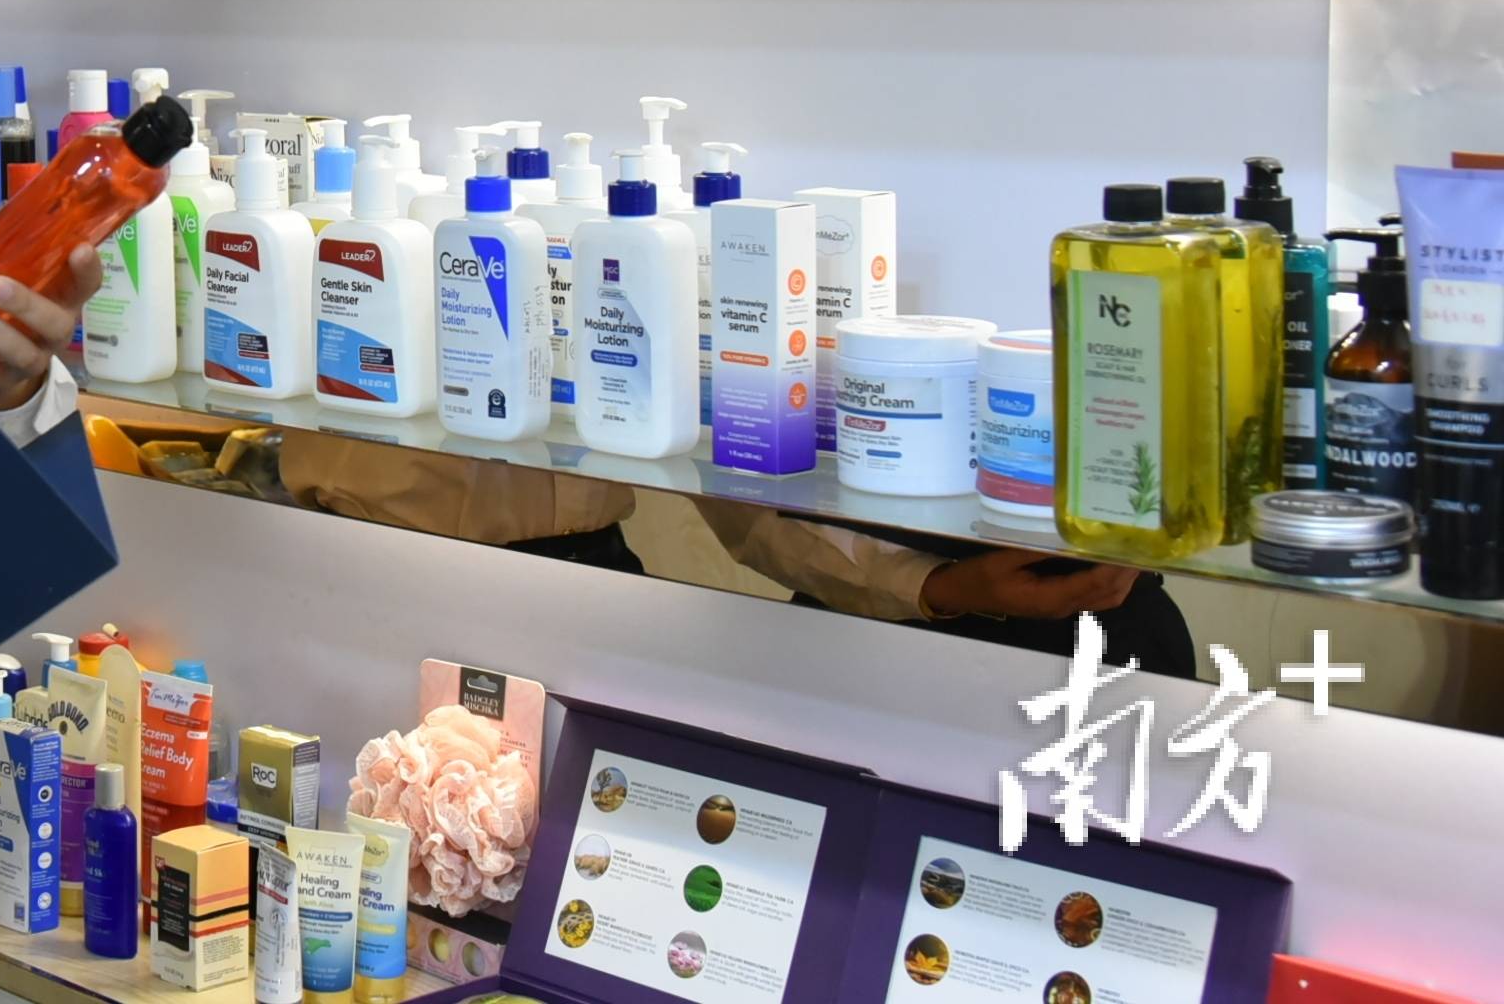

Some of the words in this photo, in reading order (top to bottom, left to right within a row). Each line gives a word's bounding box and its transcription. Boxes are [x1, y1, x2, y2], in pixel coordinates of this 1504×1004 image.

[242, 134, 302, 157] zoral
[222, 242, 247, 252] LEADER
[720, 240, 766, 253] AWAKEN
[341, 252, 371, 262] LEADER
[440, 251, 505, 279] CeraVe
[206, 267, 223, 280] Daily
[225, 271, 249, 283] Facial
[207, 280, 238, 294] Cleanser
[321, 277, 349, 290] Gentle
[351, 281, 373, 293] Skin
[321, 292, 359, 306] Cleanser
[441, 287, 460, 302] Daily
[441, 301, 492, 319] Moisturizing
[720, 296, 734, 305] skin
[735, 297, 769, 311] renewing
[816, 298, 842, 308] amin
[843, 298, 851, 308] C
[441, 313, 466, 326] Lotion
[600, 306, 625, 321] Daily
[721, 309, 758, 322] vitamin
[759, 312, 768, 323] C
[816, 309, 843, 318] erum
[584, 317, 645, 338] Moisturizing
[728, 321, 759, 334] serum
[1287, 321, 1308, 333] OIL
[598, 333, 629, 347] Lotion
[845, 378, 885, 395] Original
[1427, 373, 1489, 392] CURLS
[869, 395, 915, 409] Cream
[982, 419, 1051, 443] moisturizing
[464, 692, 501, 707] BADGLEY
[48, 700, 66, 720] GOLD
[66, 700, 89, 732] BOND
[463, 701, 499, 716] MISCHKA
[141, 724, 175, 743] Eczema
[167, 748, 194, 771] Body
[142, 765, 166, 778] ream
[253, 766, 276, 784] RoC
[296, 851, 348, 864] AWAKEN
[300, 872, 340, 890] Healing
[297, 885, 315, 896] and
[316, 888, 352, 900] Cream
[359, 886, 383, 901] aling
[362, 897, 395, 912] Cream
